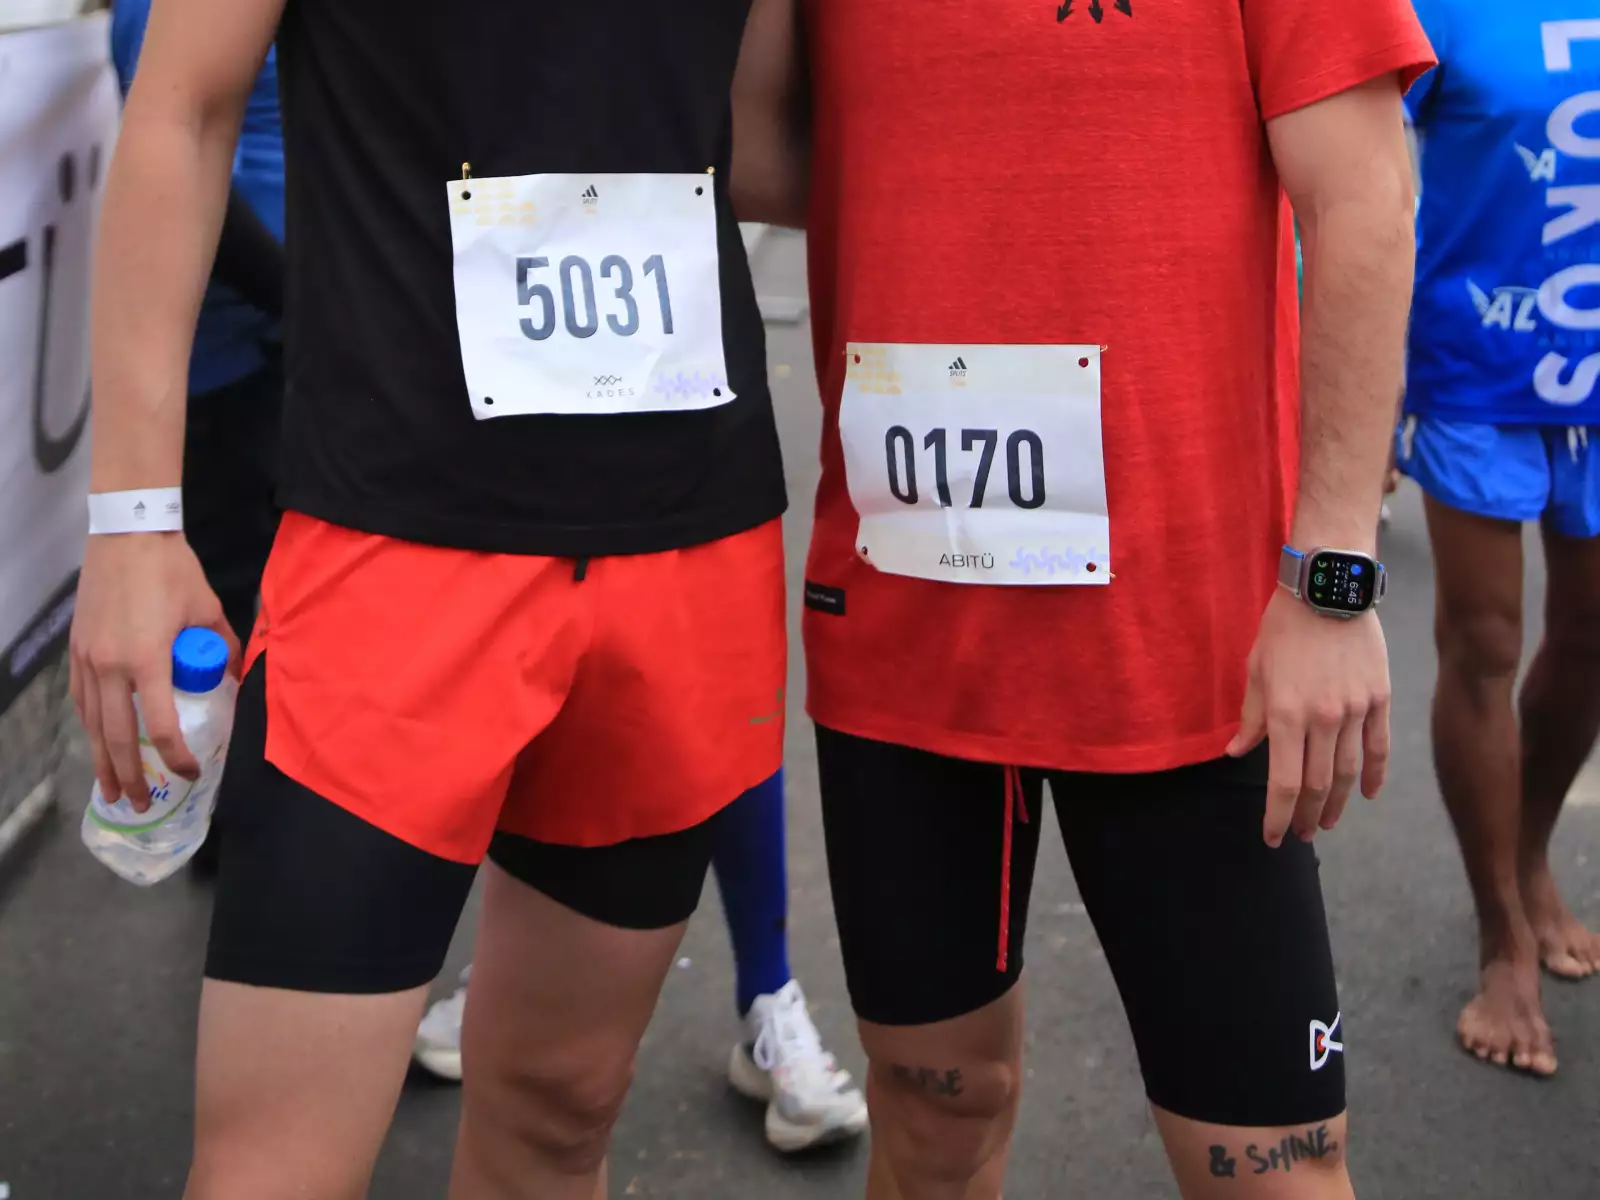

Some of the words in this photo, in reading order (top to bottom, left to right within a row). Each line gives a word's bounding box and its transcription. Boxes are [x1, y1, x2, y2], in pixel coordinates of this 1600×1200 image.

[1533, 18, 1600, 406] LOKOS
[515, 254, 675, 341] 5031
[885, 425, 1046, 509] 0170
[939, 552, 995, 569] ABITÜ
[1347, 581, 1359, 604] 6:45
[1209, 1143, 1236, 1179] &
